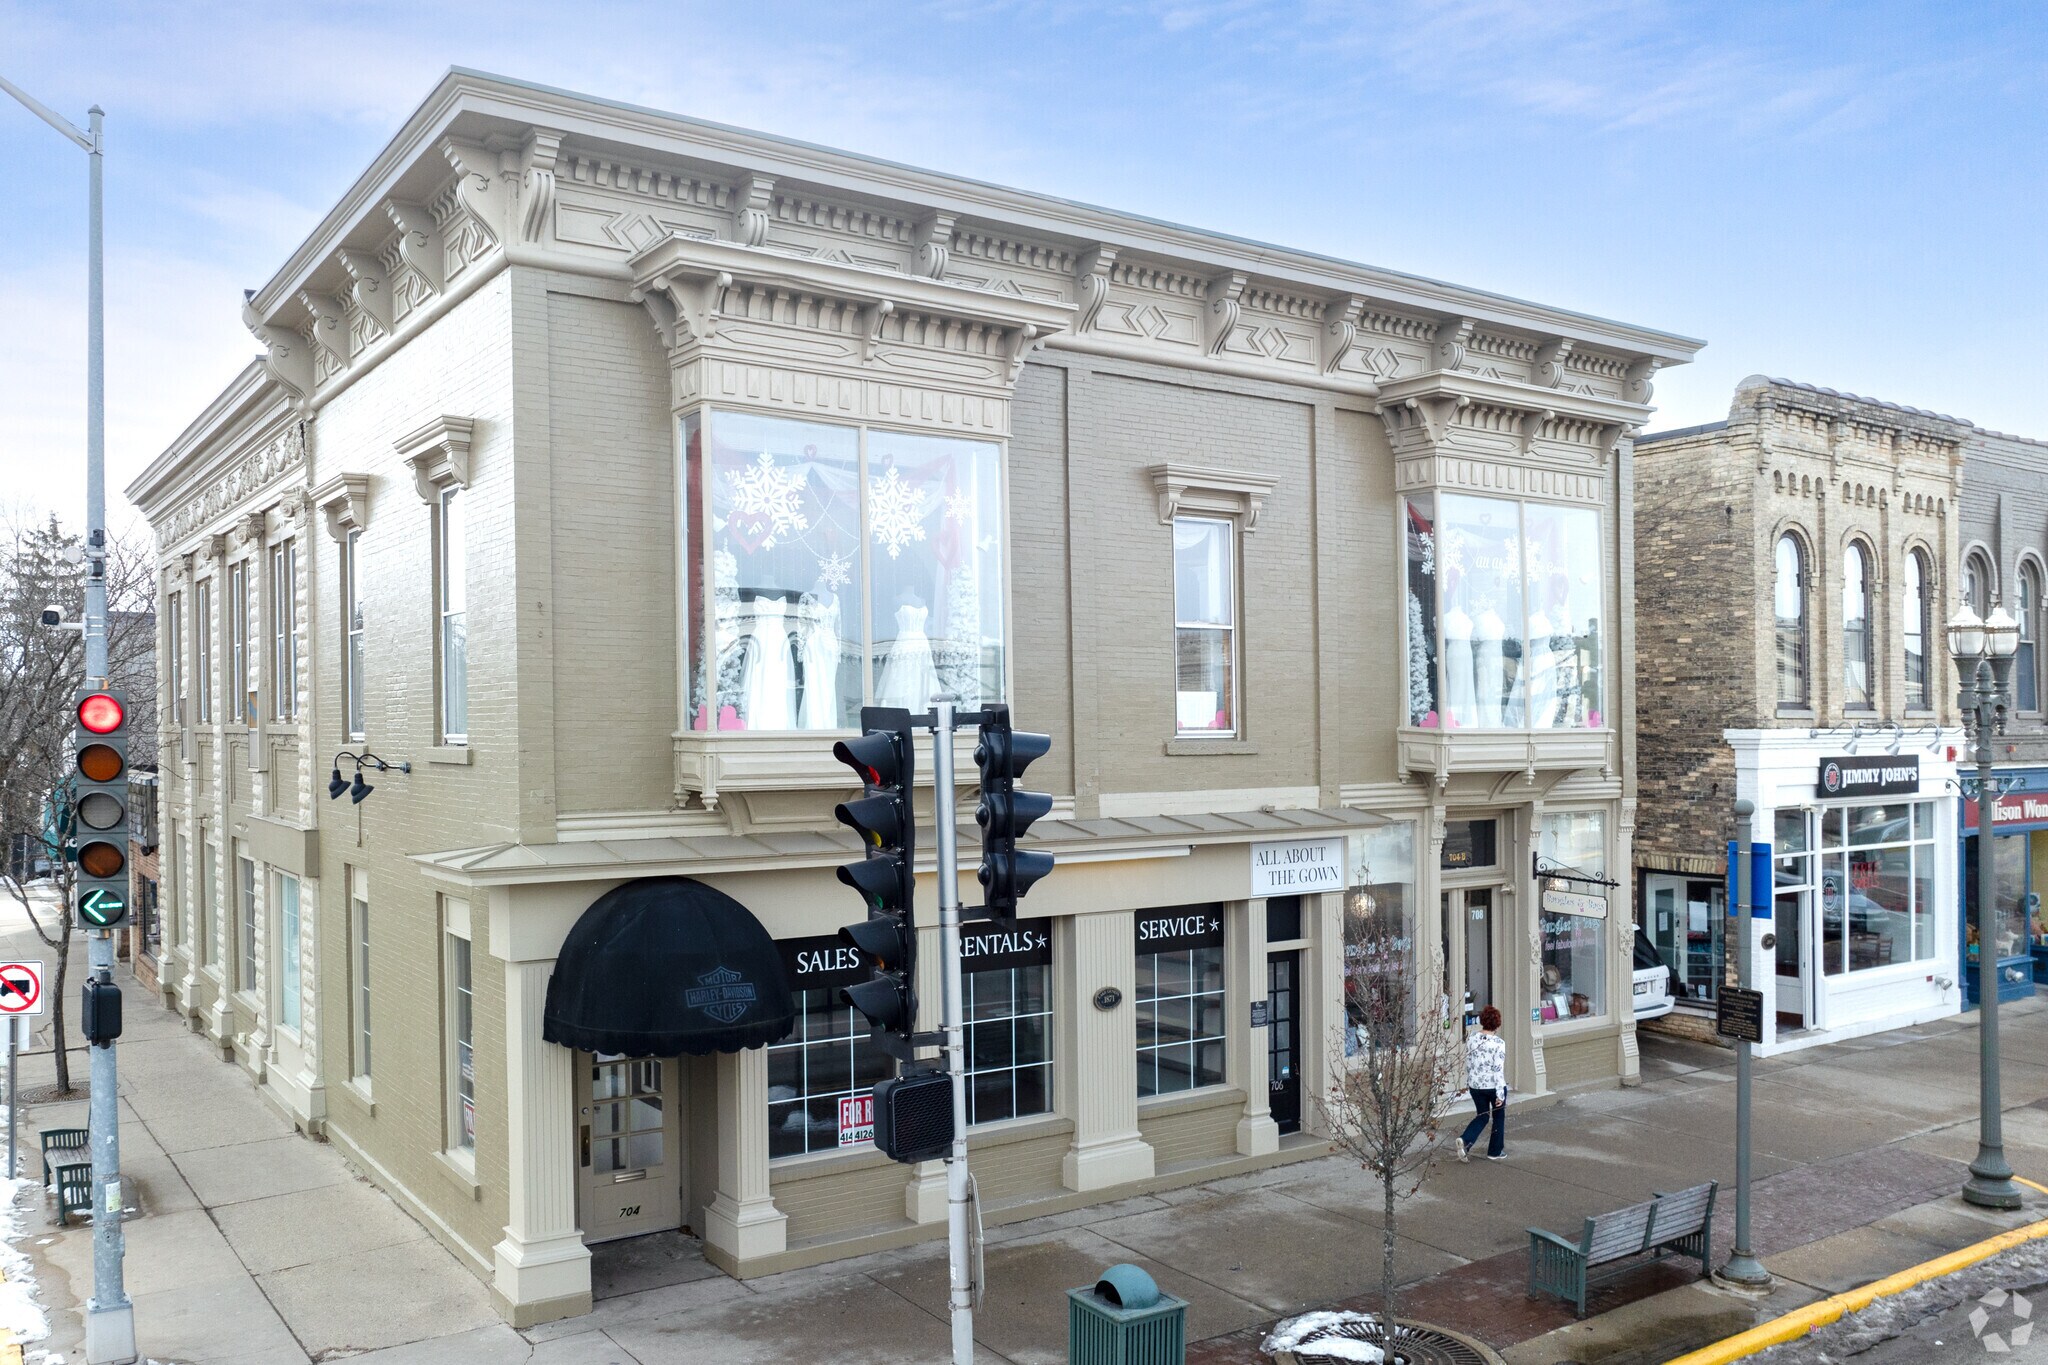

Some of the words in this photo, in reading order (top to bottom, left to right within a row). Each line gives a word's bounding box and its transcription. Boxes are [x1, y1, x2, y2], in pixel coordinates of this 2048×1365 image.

[1841, 768, 1880, 788] JIMMY
[1881, 766, 1918, 787] JOHN'S
[1991, 801, 2022, 821] llison
[1256, 850, 1281, 866] ALL
[1283, 846, 1326, 864] ABOUT
[1268, 869, 1295, 886] THE
[1298, 866, 1338, 883] GOWN
[1471, 909, 1484, 920] 708
[1140, 915, 1205, 940] SERVICE
[797, 947, 860, 974] SALES
[705, 970, 737, 985] MOTOR
[710, 1002, 742, 1019] CYCLES
[1271, 1080, 1284, 1090] 706
[843, 1101, 862, 1126] FOR
[619, 1205, 641, 1218] 704
